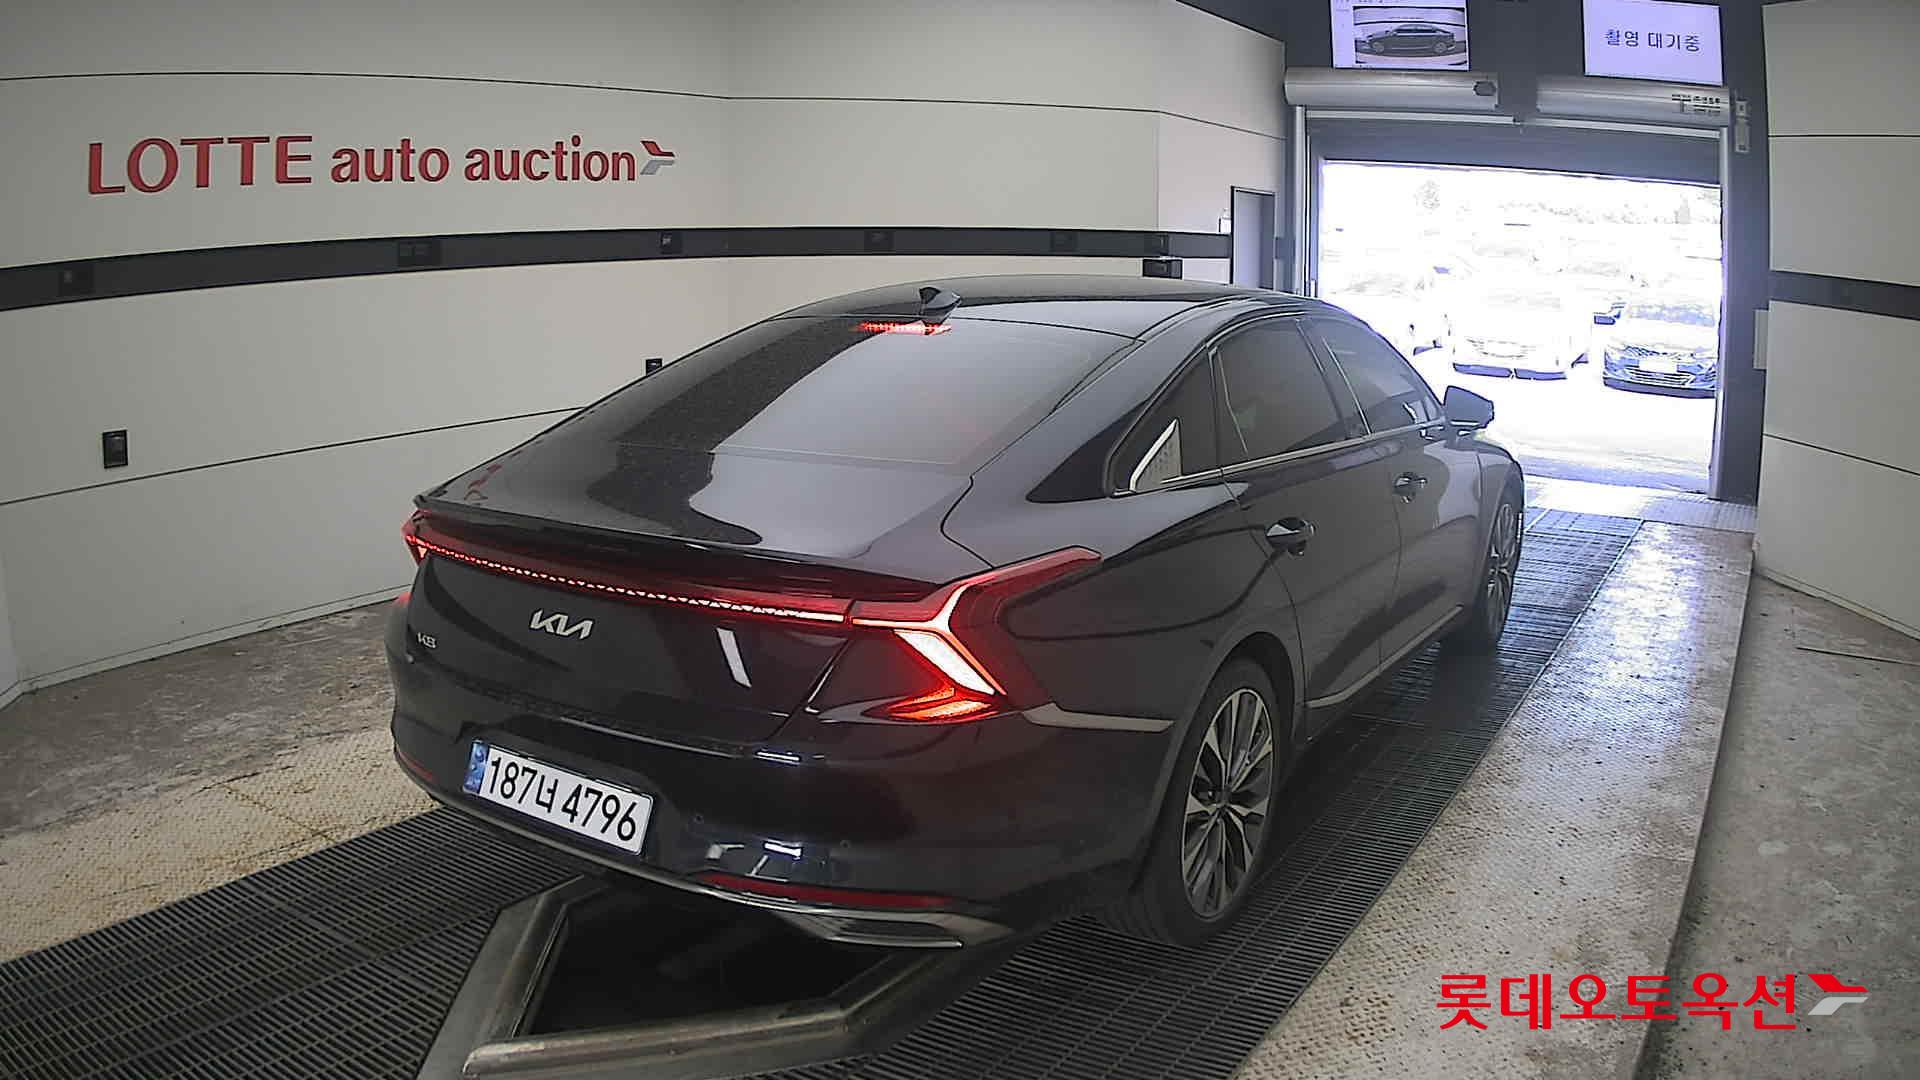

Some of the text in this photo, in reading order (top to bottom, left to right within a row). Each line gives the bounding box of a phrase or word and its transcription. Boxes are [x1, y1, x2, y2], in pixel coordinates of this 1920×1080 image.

[1605, 29, 1700, 52] 촬영 대기중
[88, 135, 637, 195] LOTTE auto auction
[417, 631, 437, 649] K8
[529, 608, 594, 640] KIA
[490, 756, 637, 841] 187너 4796
